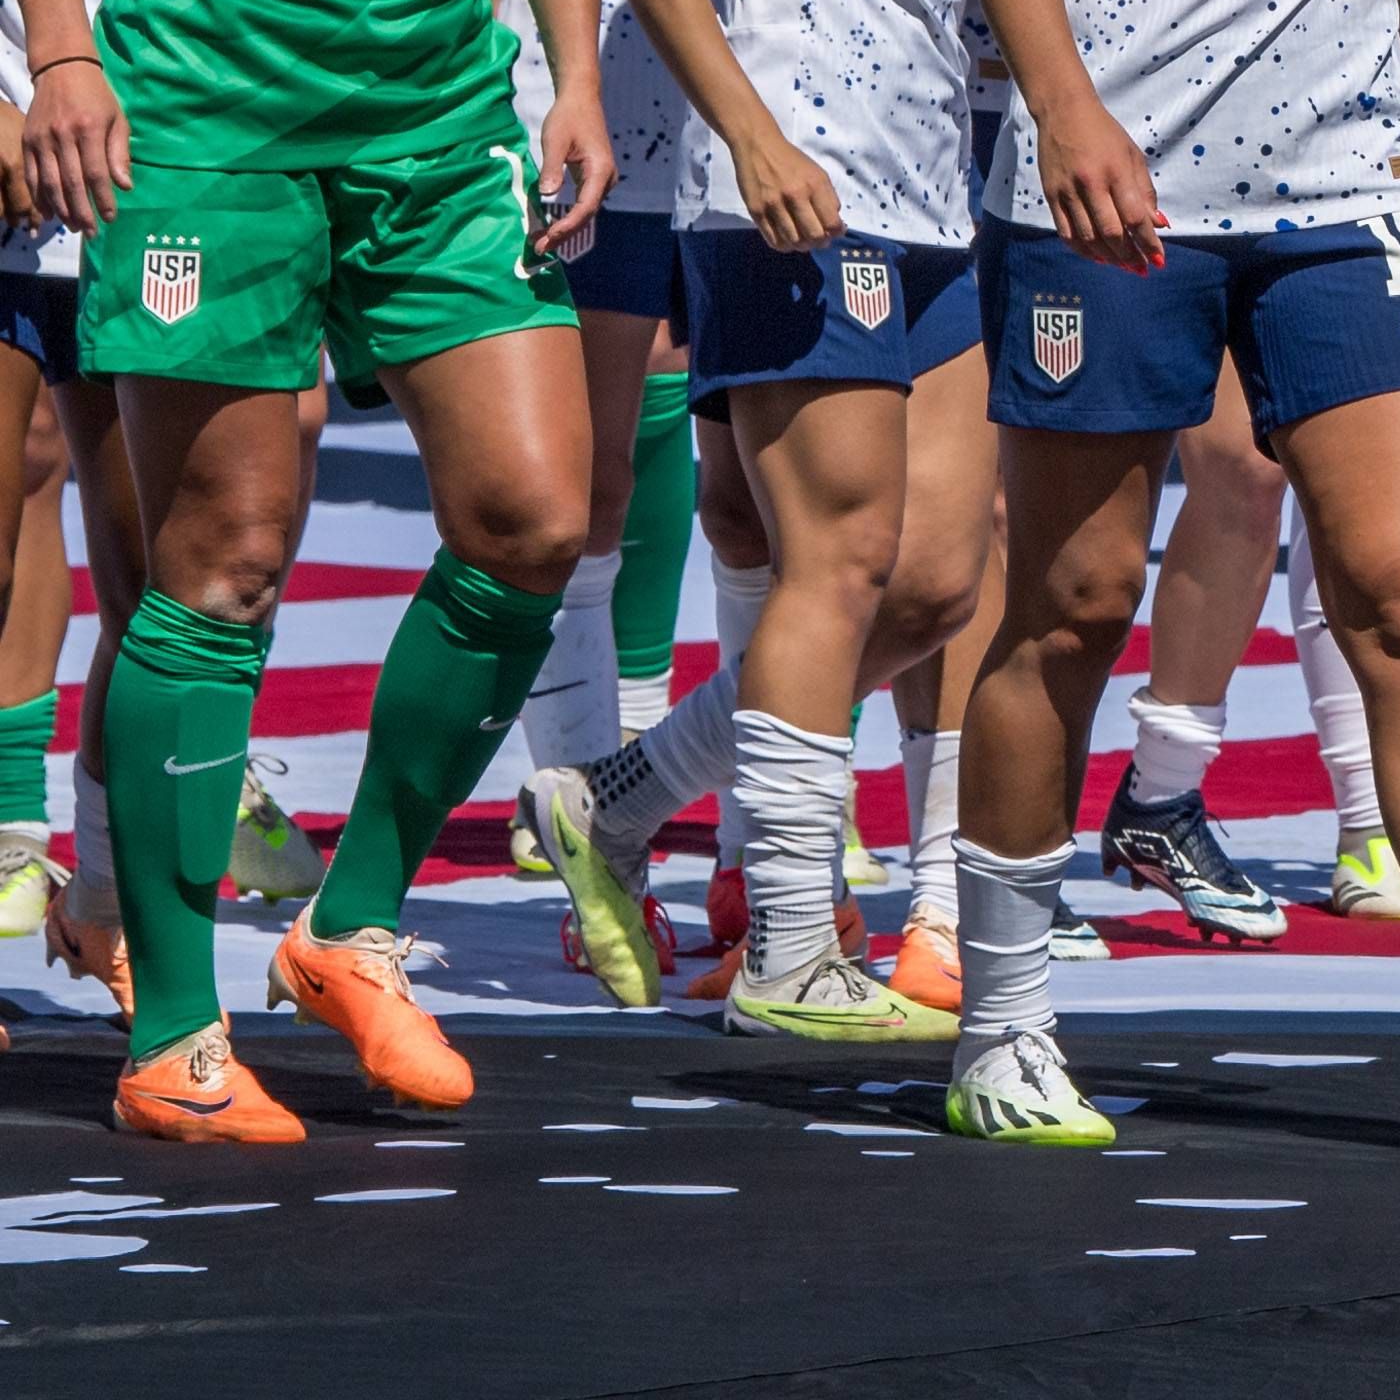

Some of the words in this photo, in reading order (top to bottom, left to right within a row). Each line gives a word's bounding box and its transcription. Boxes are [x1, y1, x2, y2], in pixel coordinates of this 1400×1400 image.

[147, 254, 196, 282] USA
[846, 267, 884, 291] USA
[1037, 312, 1078, 341] USA
